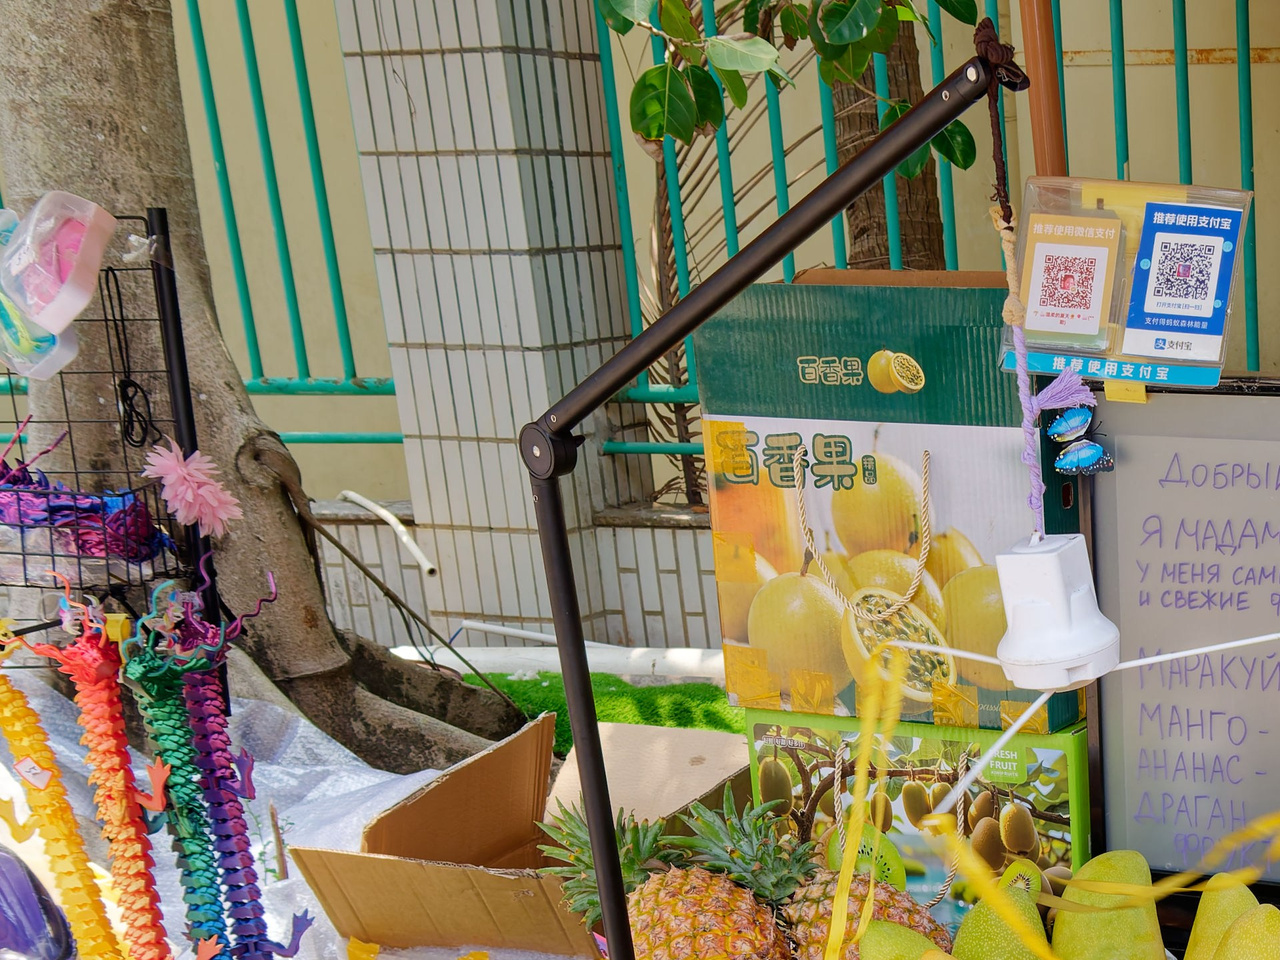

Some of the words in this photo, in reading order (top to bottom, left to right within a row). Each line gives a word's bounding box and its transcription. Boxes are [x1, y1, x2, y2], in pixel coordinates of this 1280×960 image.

[1033, 223, 1116, 240] 推荐使用微信支付
[1153, 212, 1232, 230] 推荐使用支付宝
[1167, 339, 1193, 351] 支付宝
[796, 354, 864, 387] 百香果
[1052, 356, 1169, 381] 推荐使用支付宝
[715, 430, 858, 492] 百香果
[1140, 514, 1164, 549] Я
[1135, 558, 1151, 584] У
[1160, 561, 1221, 585] МЕНЯ
[1160, 589, 1251, 611] СВЕЖИЕ
[1138, 702, 1248, 746] МАНГО
[989, 760, 1018, 772] FRUIT
[1136, 747, 1244, 785] АНАНАС
[1132, 790, 1248, 833] ДРАГАН
[1174, 832, 1274, 875] ФРКТ
